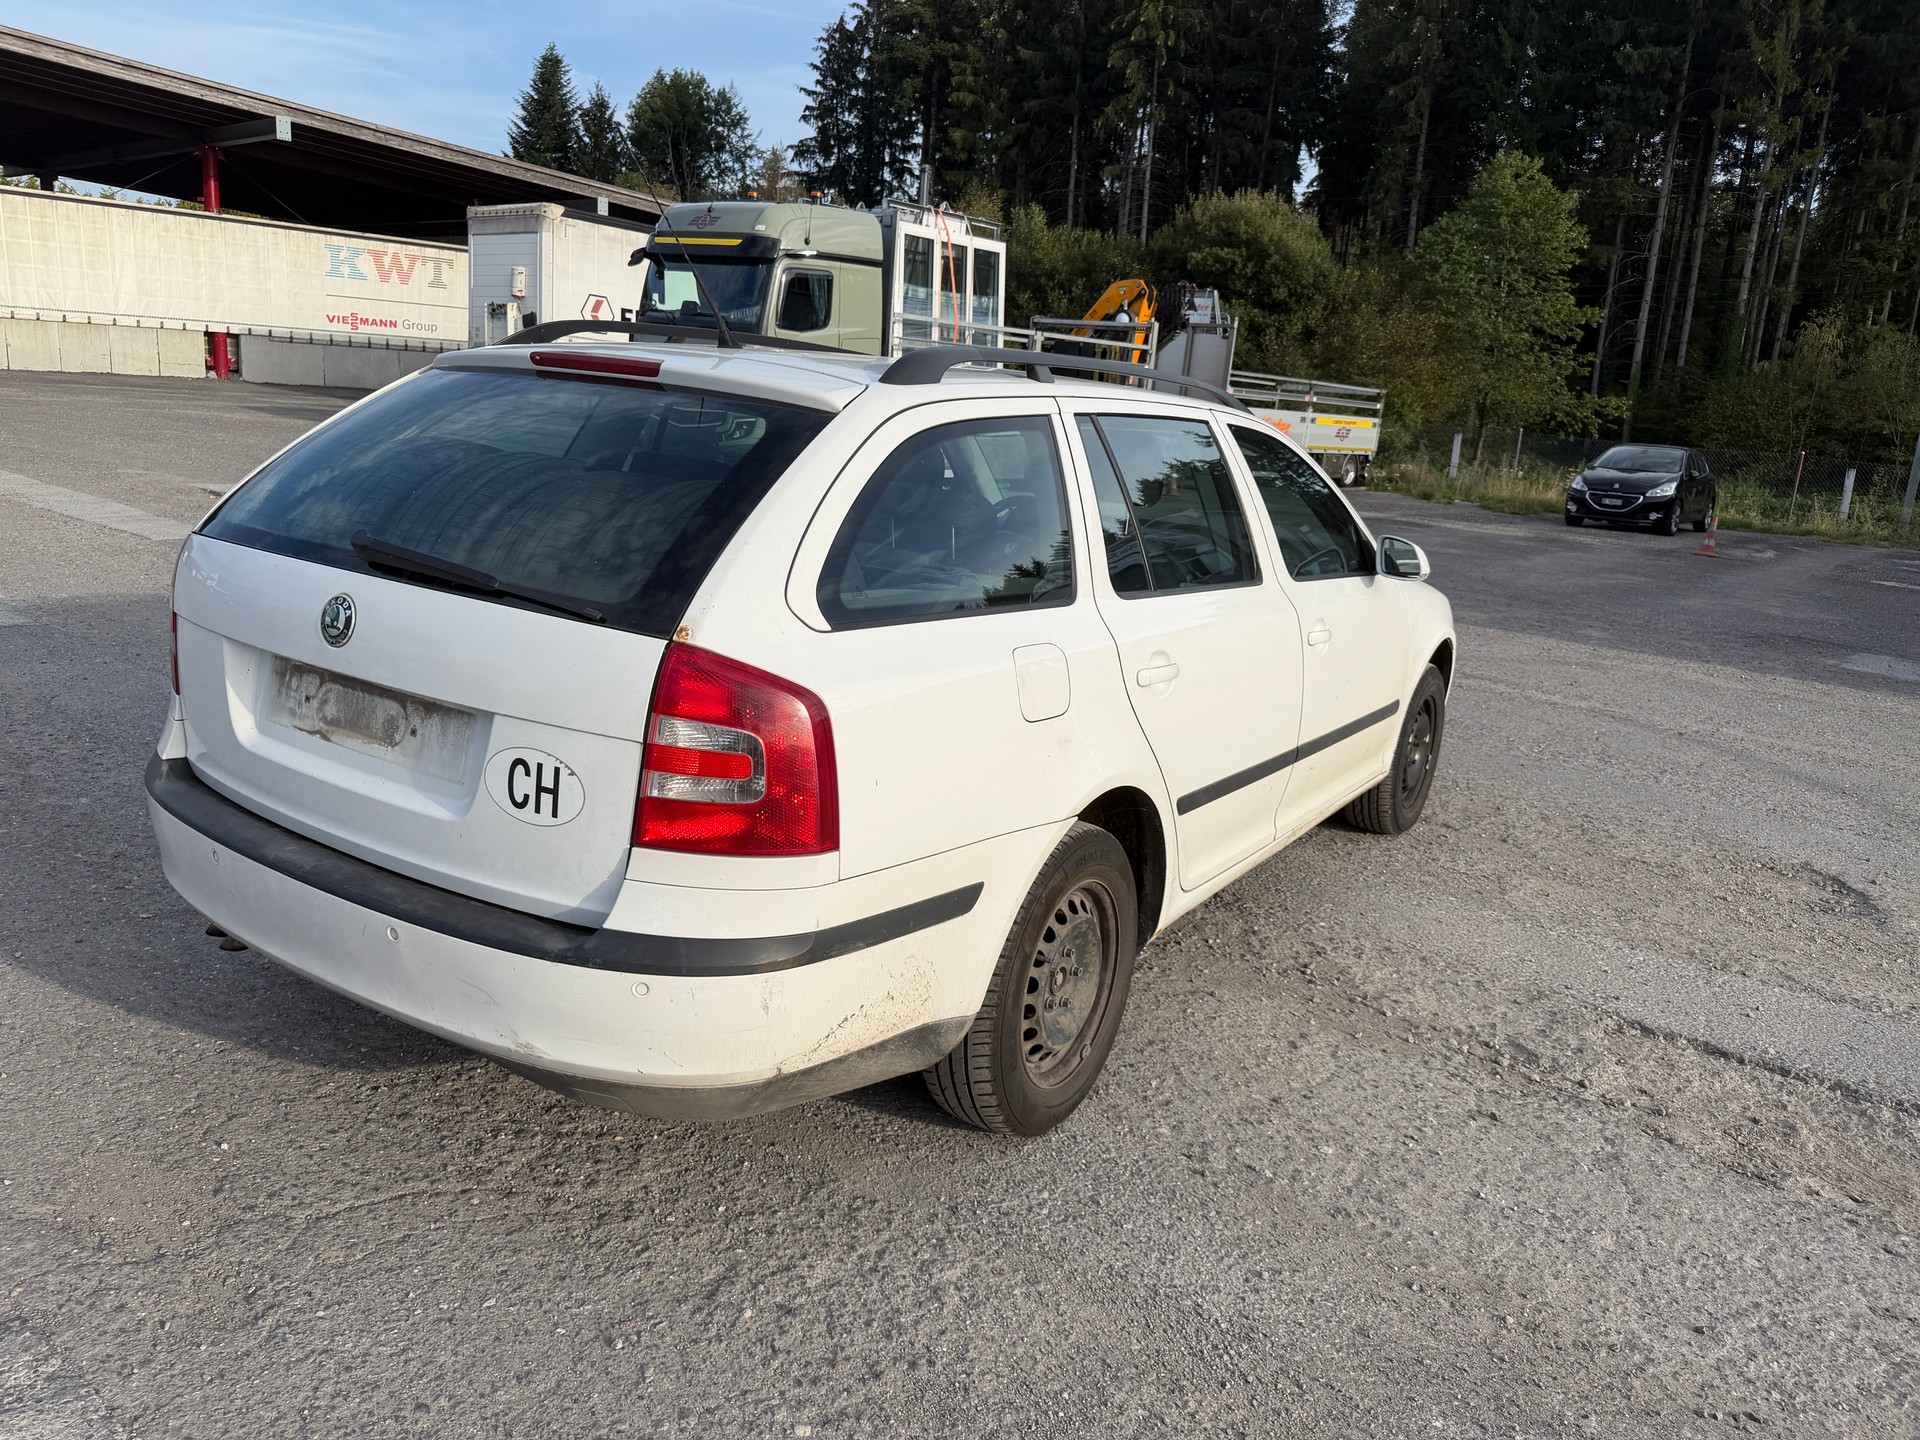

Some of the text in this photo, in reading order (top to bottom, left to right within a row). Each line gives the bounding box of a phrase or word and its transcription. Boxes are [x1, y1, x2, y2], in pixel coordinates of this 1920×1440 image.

[324, 244, 454, 289] KWT
[326, 312, 438, 334] VIESSMANN Group
[507, 757, 561, 819] CH
